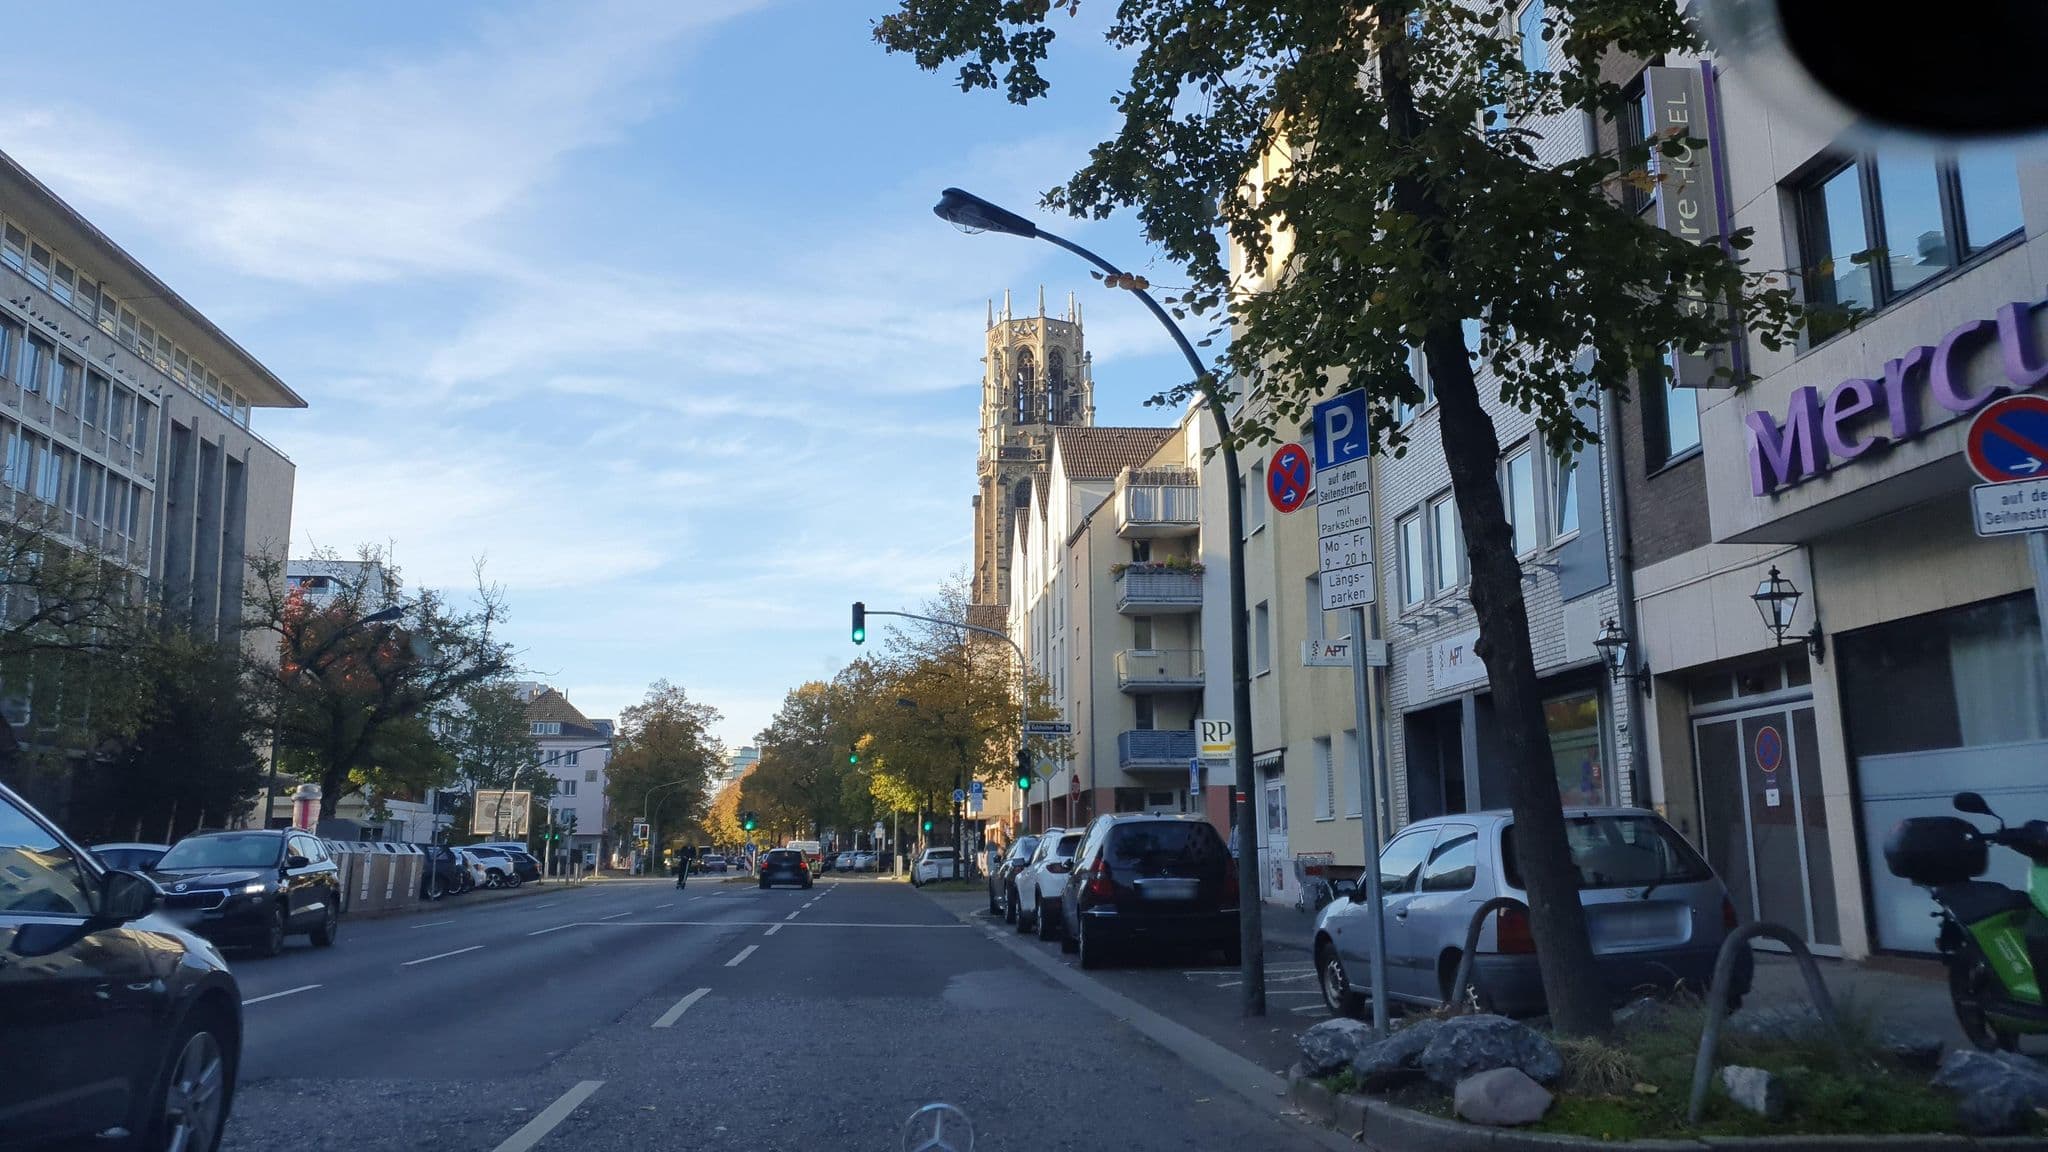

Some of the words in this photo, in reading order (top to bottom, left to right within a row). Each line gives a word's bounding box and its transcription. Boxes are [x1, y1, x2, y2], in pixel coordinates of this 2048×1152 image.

[1667, 92, 1695, 183] HOEL
[1324, 405, 1354, 463] P
[1328, 473, 1339, 486] auf
[1342, 470, 1357, 482] dem
[1320, 481, 1367, 502] Seitenstreifen
[1336, 506, 1351, 518] mit
[1321, 515, 1368, 534] Parkschein
[1325, 541, 1340, 554] Mo
[1353, 534, 1365, 547] Fr
[1325, 558, 1331, 569] 9
[1344, 552, 1357, 566] 20
[1361, 550, 1367, 562] h
[1329, 573, 1365, 588] Längs-
[1330, 589, 1366, 607] parken
[1201, 721, 1232, 742] RP
